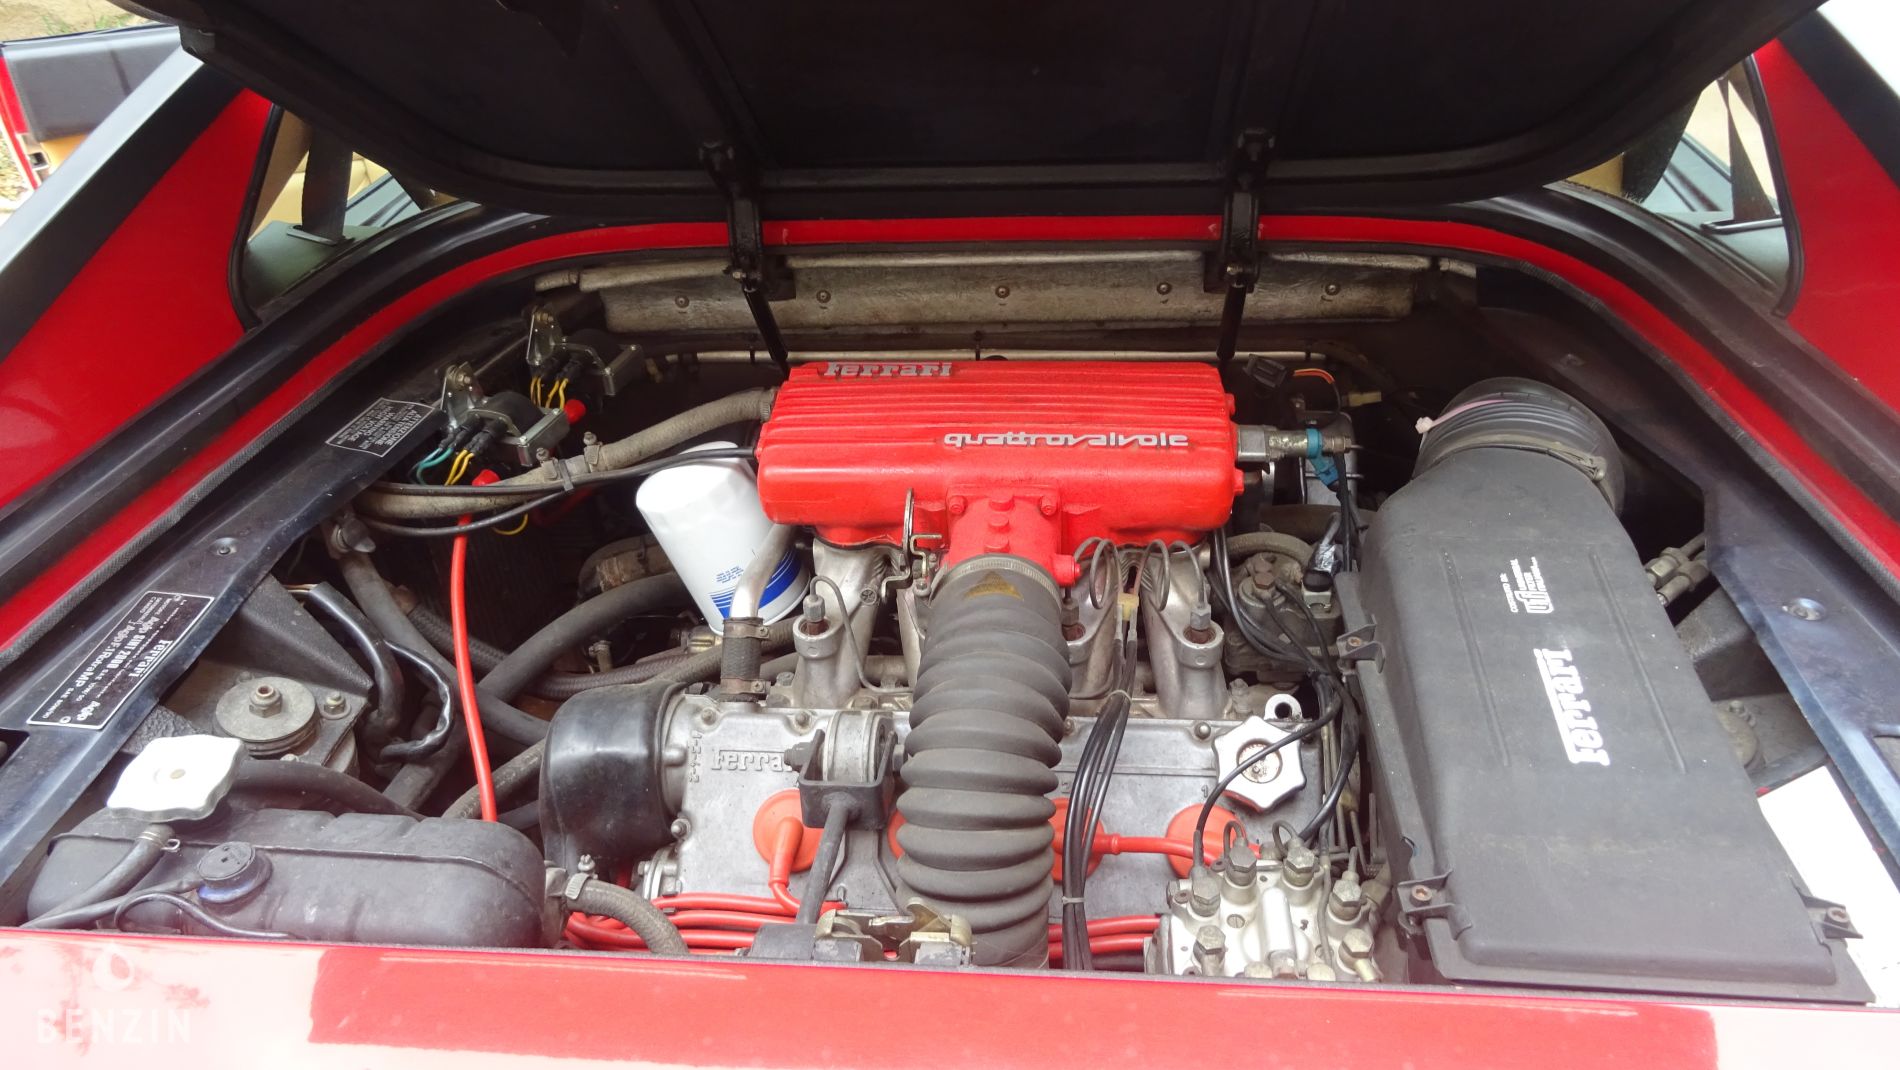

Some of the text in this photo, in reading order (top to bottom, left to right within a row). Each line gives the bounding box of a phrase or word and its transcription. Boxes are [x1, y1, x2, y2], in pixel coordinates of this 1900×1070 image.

[824, 362, 952, 377] Ferrari
[347, 420, 377, 442] VOLTAGE
[364, 412, 395, 436] WARNING
[384, 414, 422, 446] ATTENZIONE
[943, 433, 1189, 448] quattrovalvole
[138, 616, 161, 634] Agip
[124, 634, 146, 650] SINT
[106, 650, 132, 669] 2000
[128, 640, 174, 678] Ferrari
[76, 701, 101, 721] Agip
[1533, 648, 1611, 767] Ferrari
[711, 748, 793, 773] Ferra
